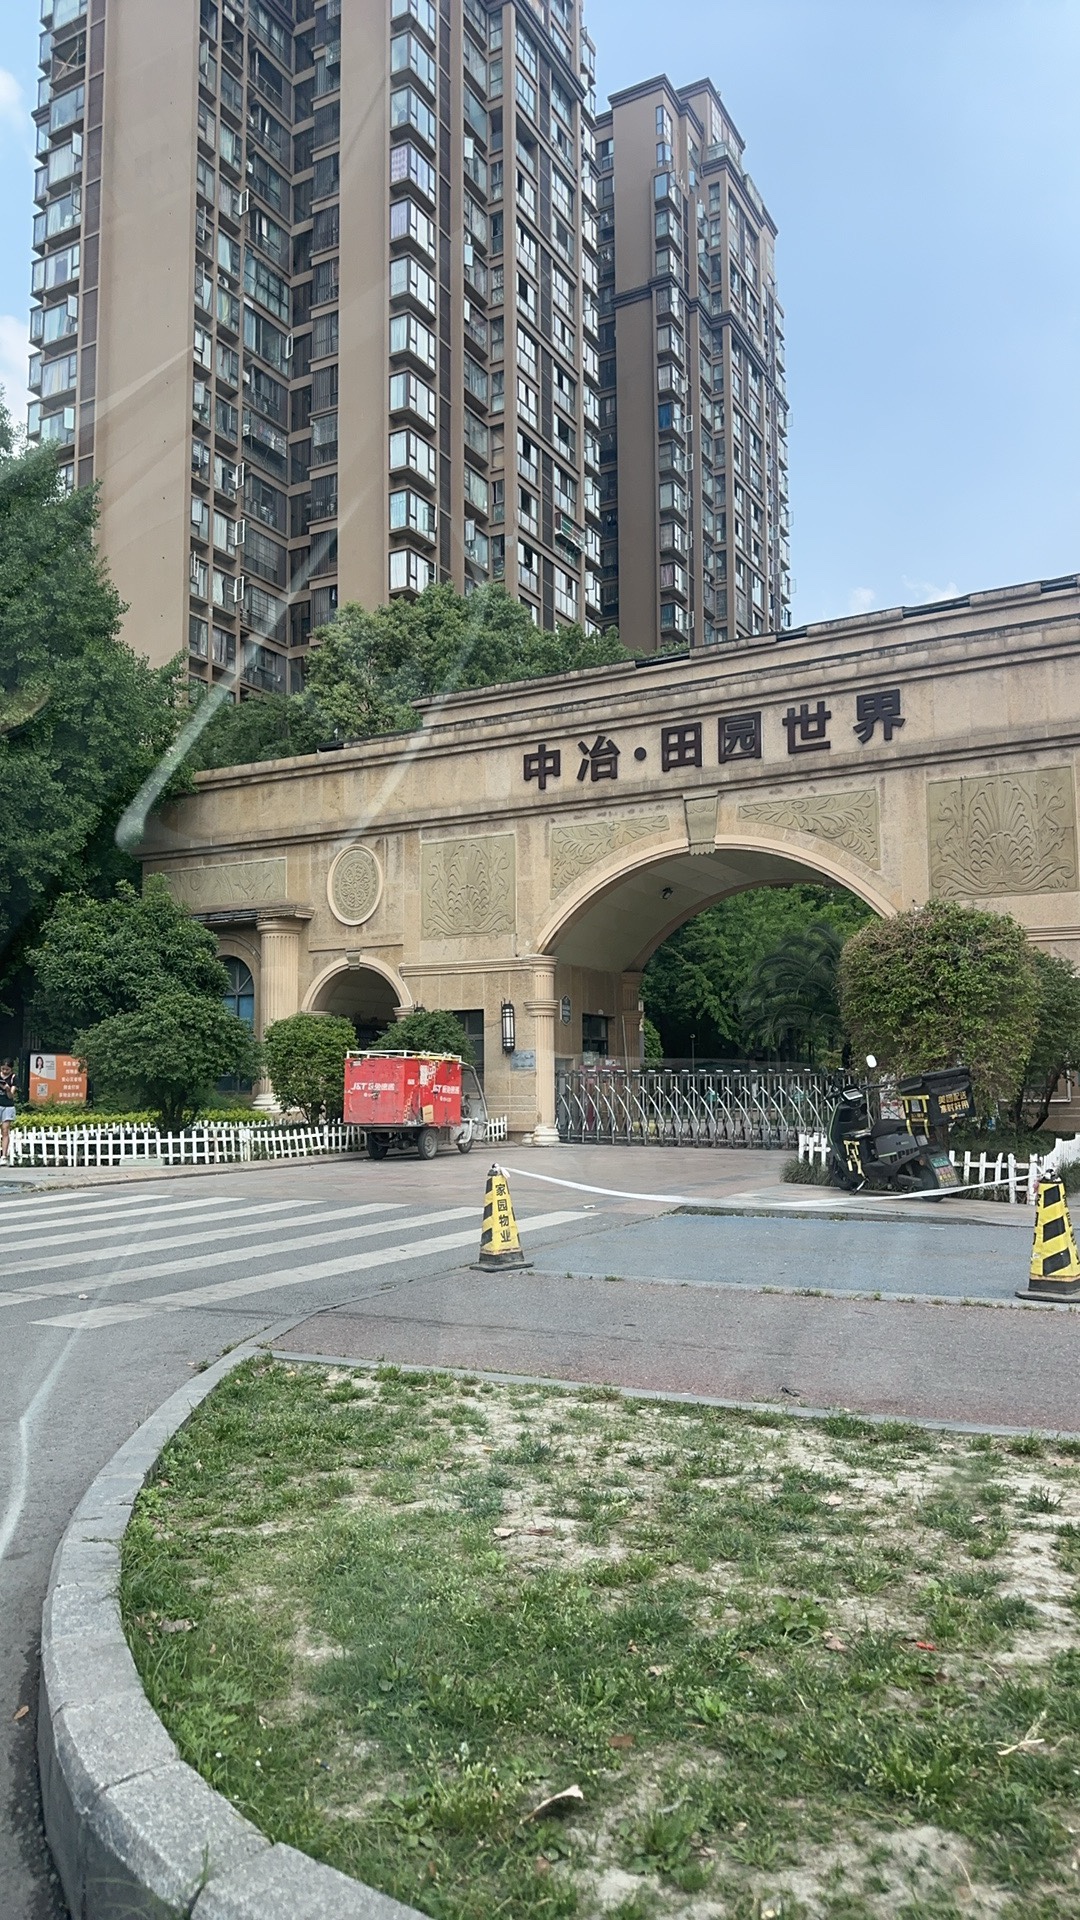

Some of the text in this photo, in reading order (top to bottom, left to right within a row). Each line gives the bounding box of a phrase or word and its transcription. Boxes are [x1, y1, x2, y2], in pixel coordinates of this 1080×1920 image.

[523, 689, 906, 790] 中冶·田园世界
[495, 1184, 511, 1243] 家园物业
